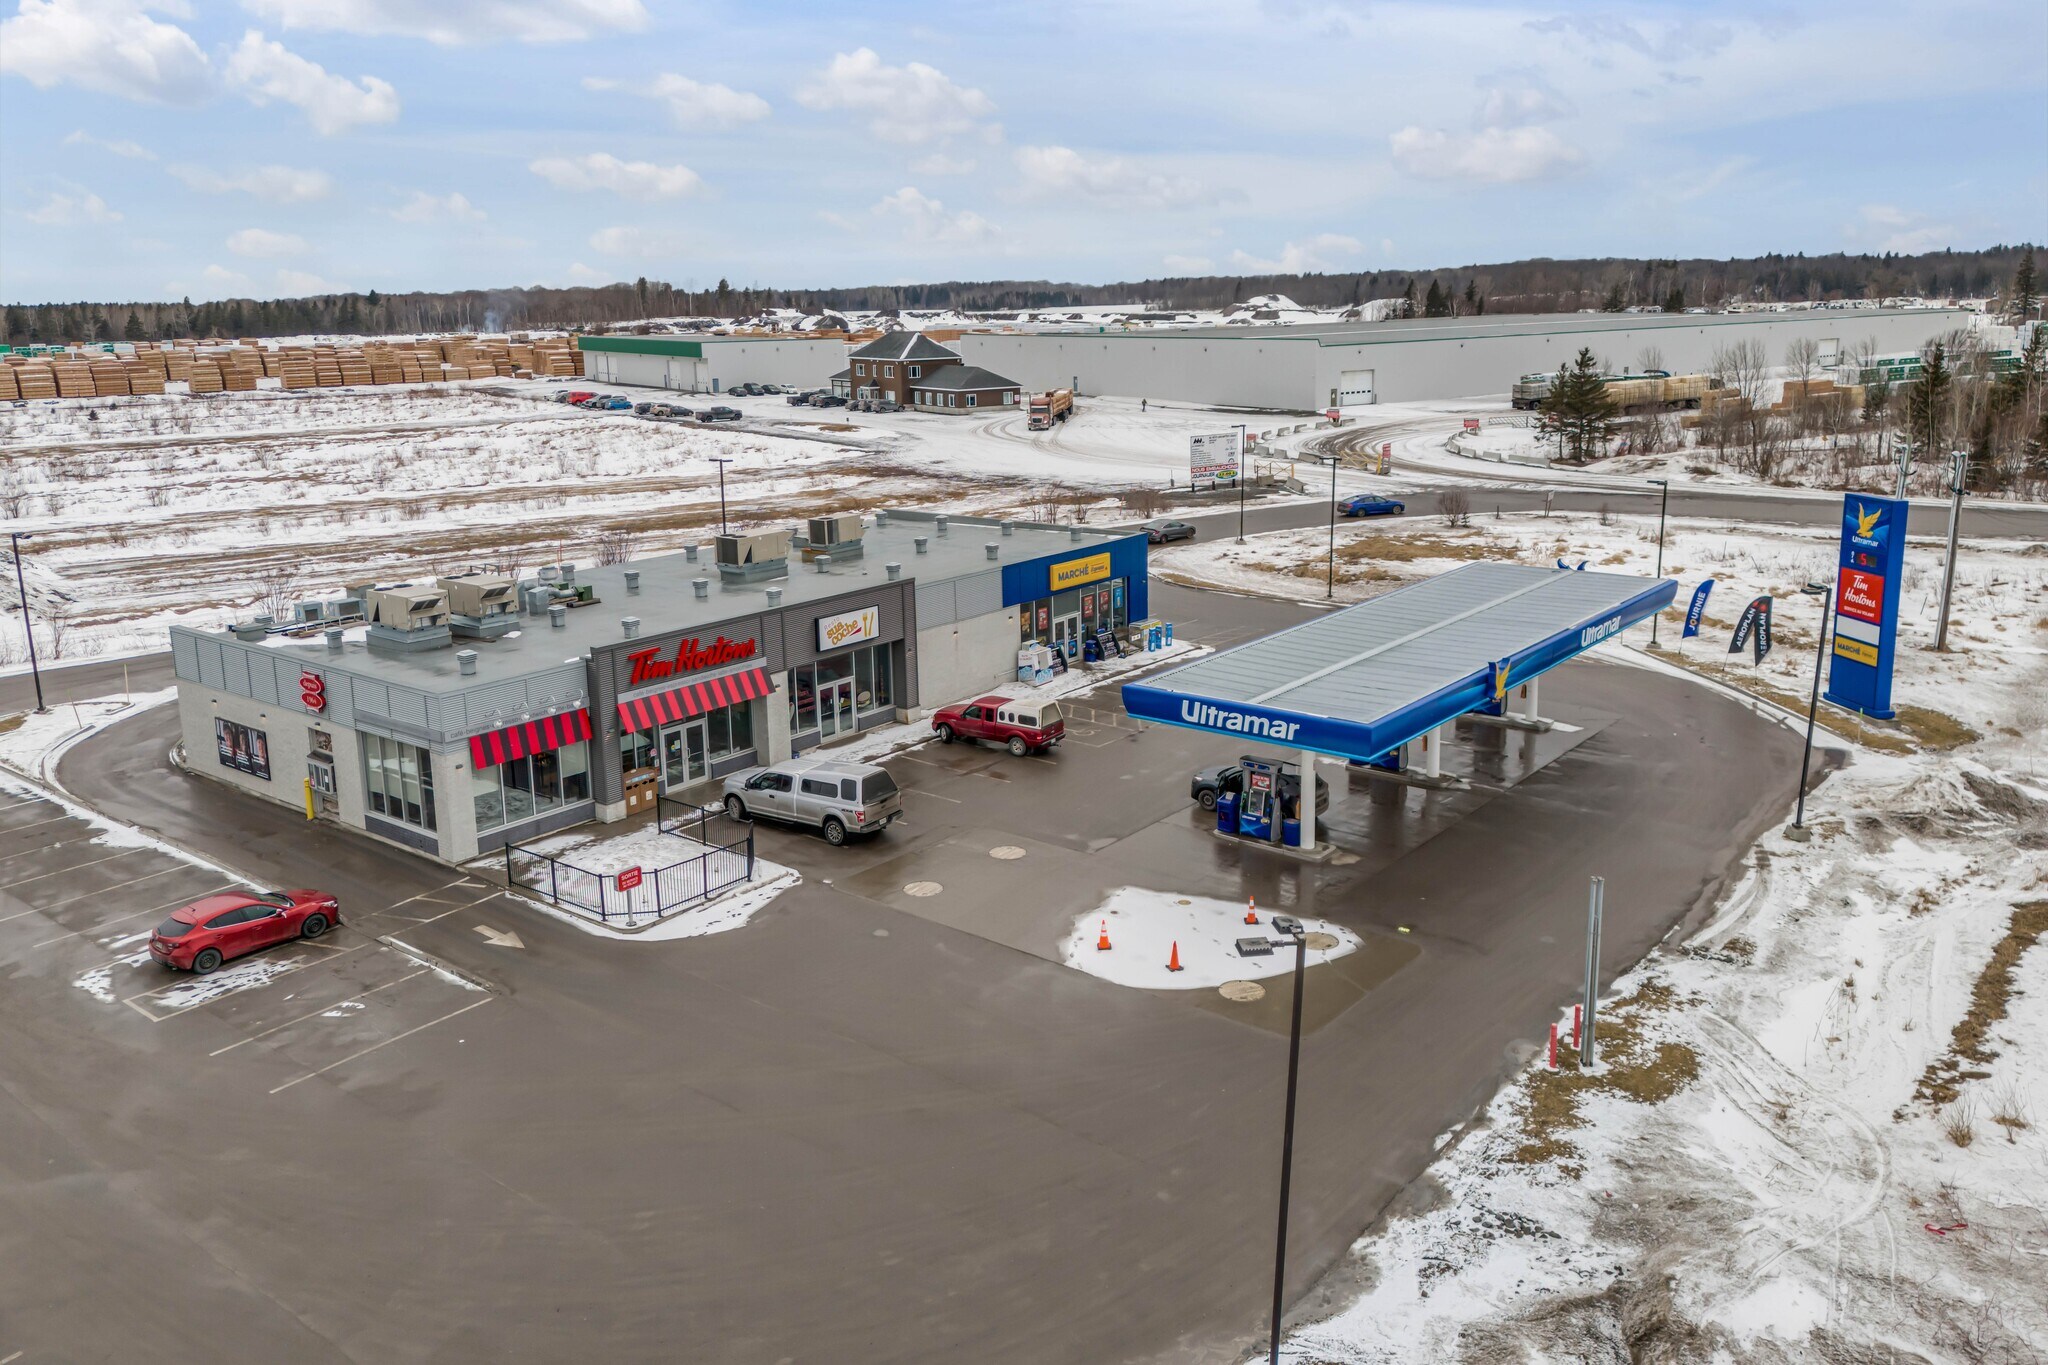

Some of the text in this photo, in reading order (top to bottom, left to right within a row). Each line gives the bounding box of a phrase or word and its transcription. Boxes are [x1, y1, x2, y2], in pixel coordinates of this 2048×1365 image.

[1058, 564, 1089, 581] MARCHÉ
[1853, 574, 1868, 591] Tim
[1689, 591, 1706, 631] JOURNIE
[1844, 587, 1876, 608] Hortons
[826, 621, 845, 639] sua
[831, 619, 859, 646] coche
[1581, 615, 1621, 647] Ultramar
[1736, 607, 1757, 647] AEROPLAN
[1760, 612, 1768, 655] AEROPLAN
[627, 647, 674, 686] Tim
[675, 635, 756, 673] Hortons
[1181, 700, 1300, 741] Ultramar
[621, 870, 639, 881] SORTIE
